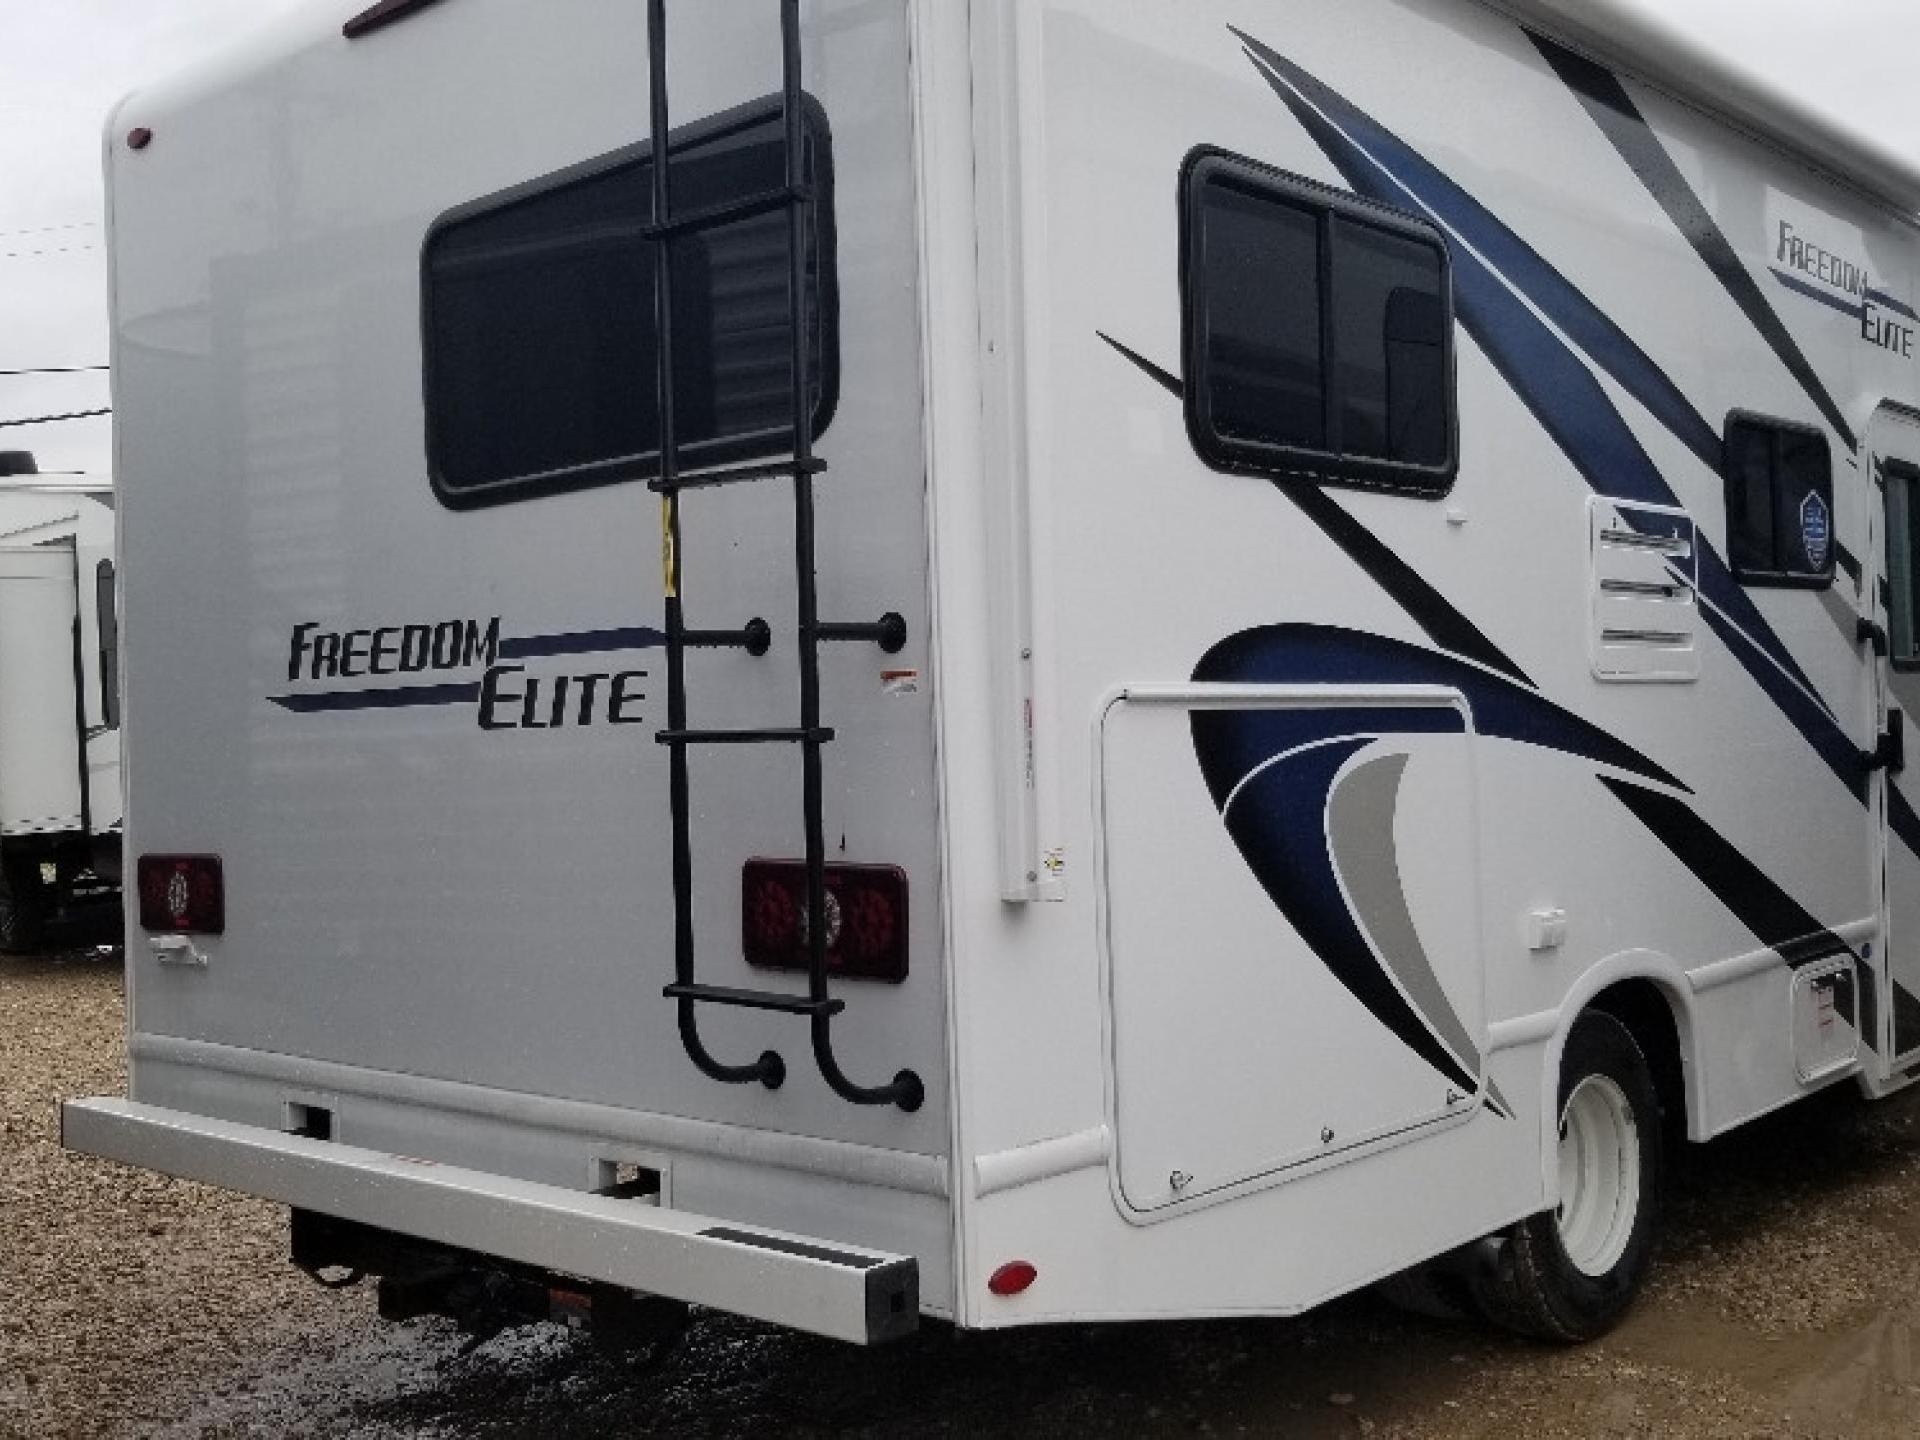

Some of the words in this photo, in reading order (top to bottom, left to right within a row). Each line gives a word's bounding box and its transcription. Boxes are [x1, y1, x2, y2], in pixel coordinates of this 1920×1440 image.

[1777, 220, 1867, 297] FREEDOM
[1862, 303, 1913, 359] ELITE
[289, 616, 500, 681] FREEDOM
[478, 665, 648, 731] ELITE
